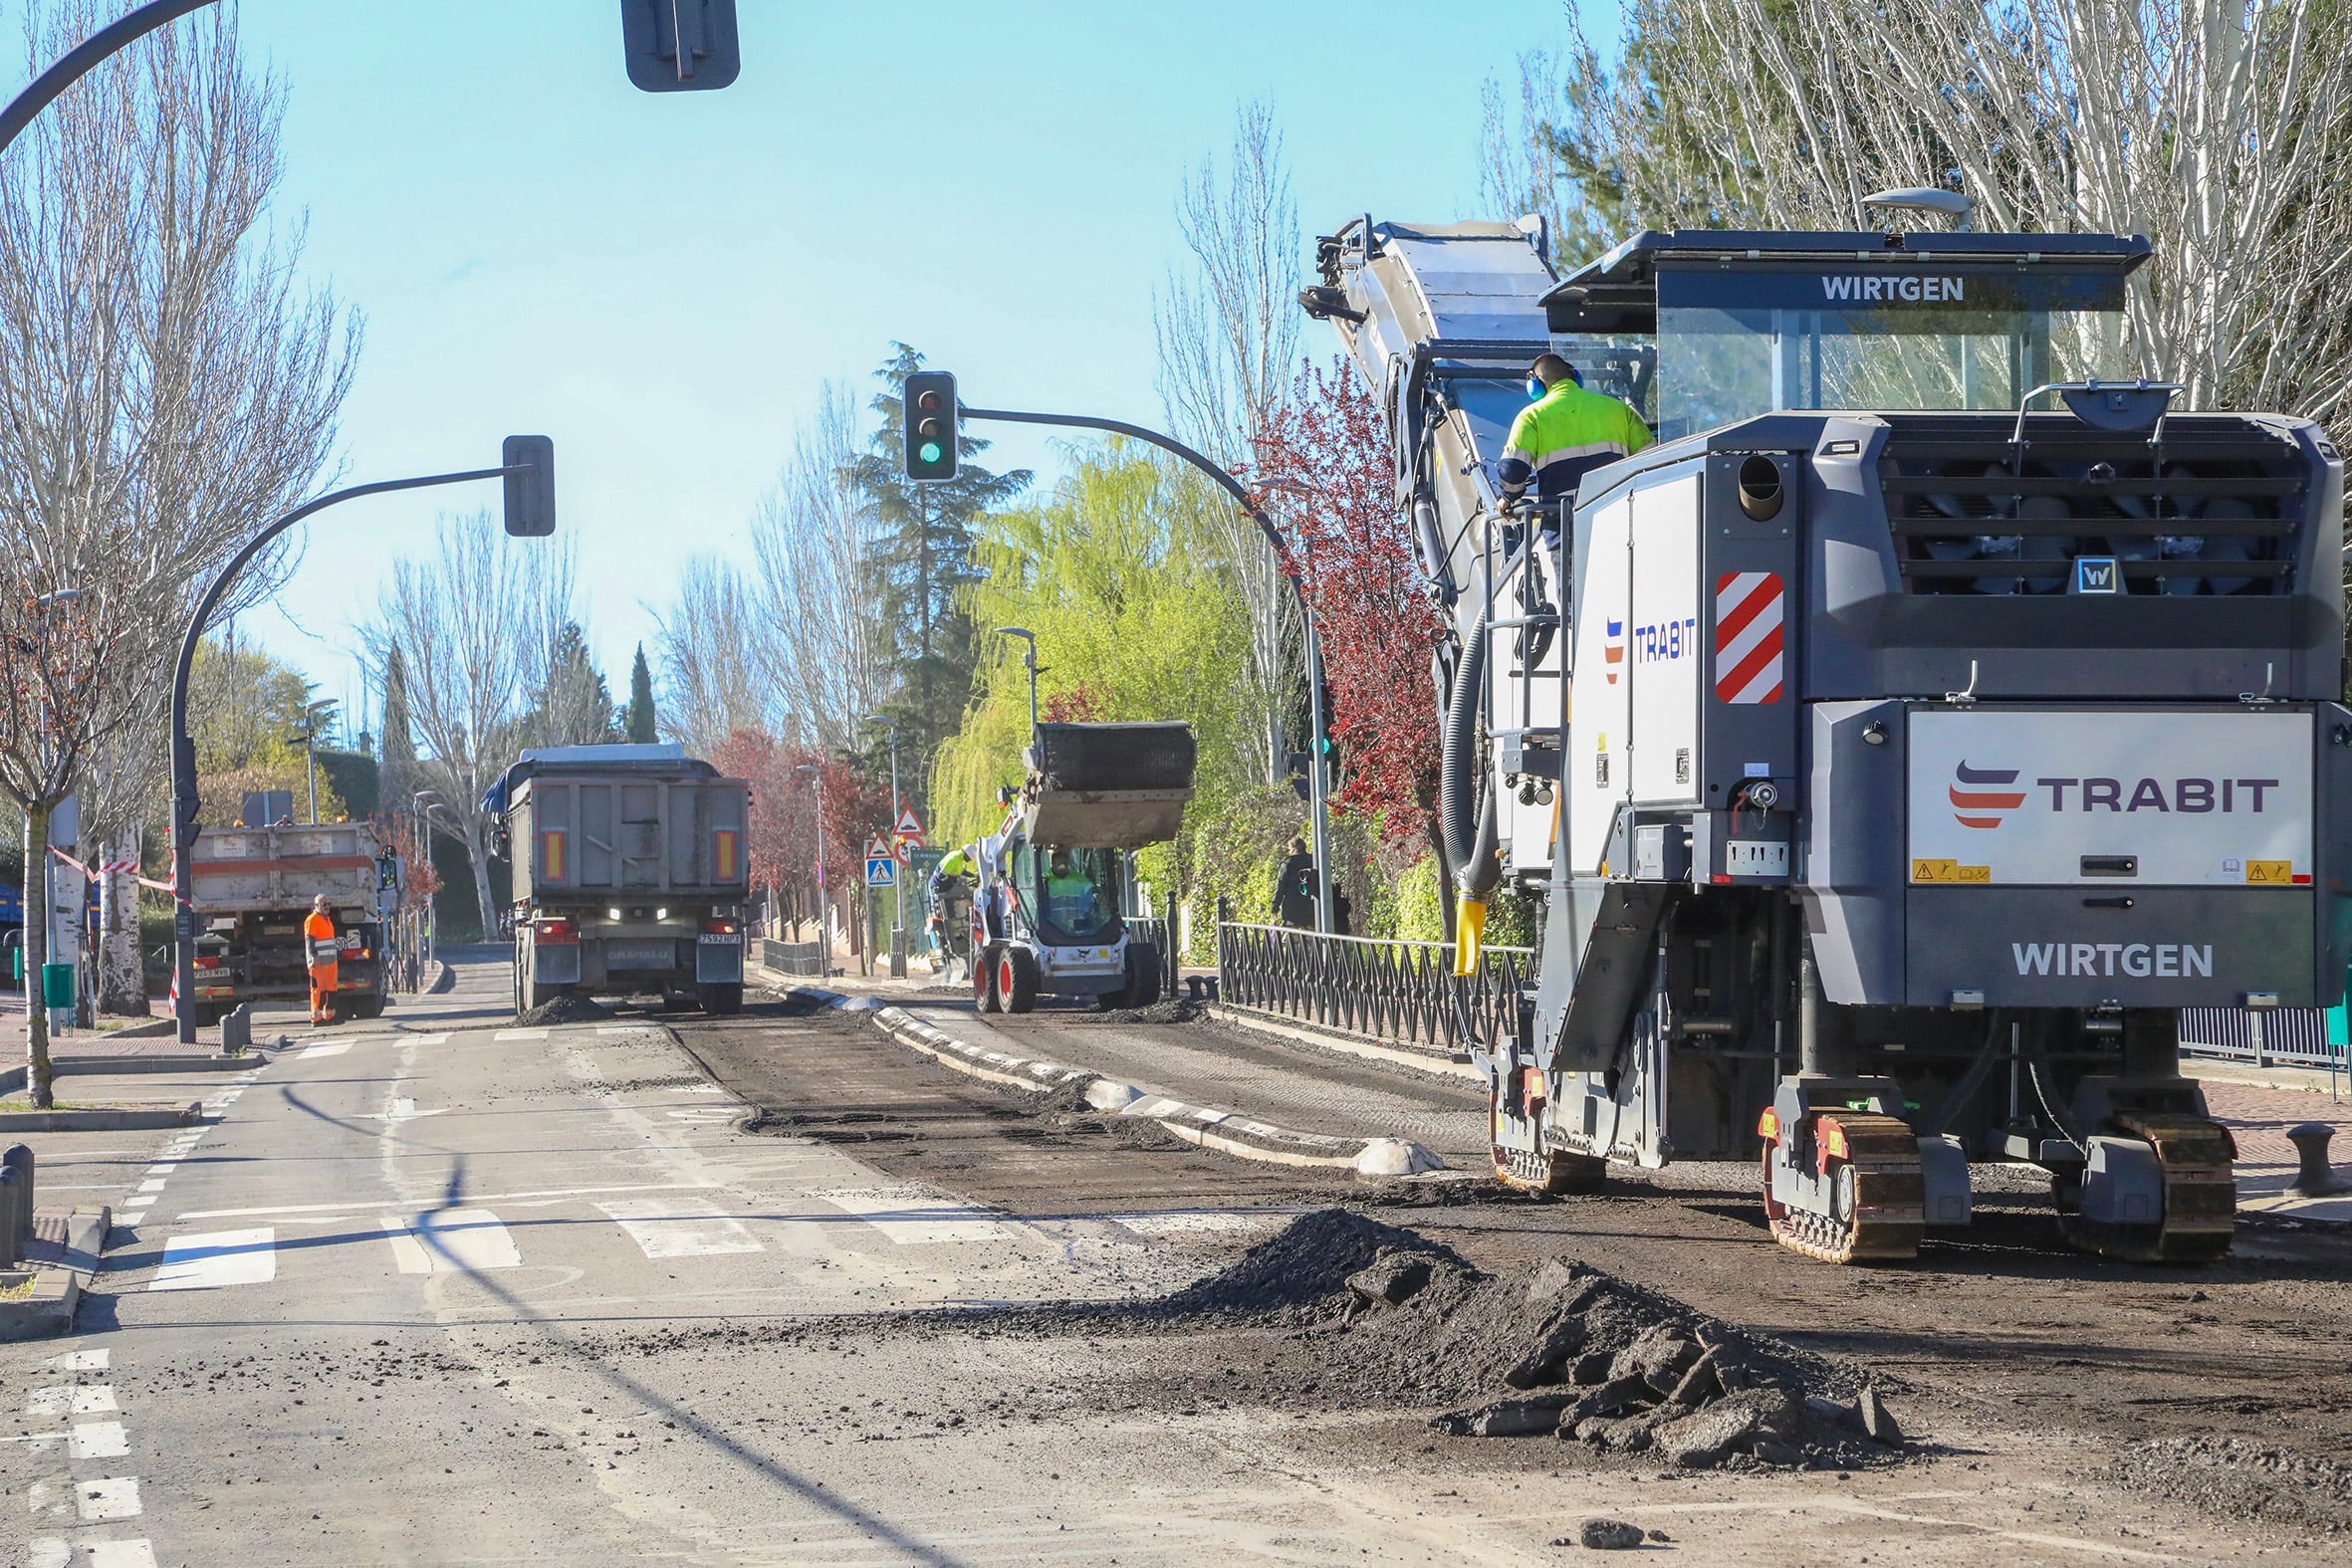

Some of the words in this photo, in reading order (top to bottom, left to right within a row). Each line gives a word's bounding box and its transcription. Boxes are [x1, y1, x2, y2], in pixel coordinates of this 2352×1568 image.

[1821, 276, 1964, 301] WIRTGEN
[2083, 566, 2111, 585] W
[1636, 618, 1696, 664] TRABIT
[2037, 779, 2279, 812] TRABIT
[2011, 943, 2213, 978] WIRTGEN
